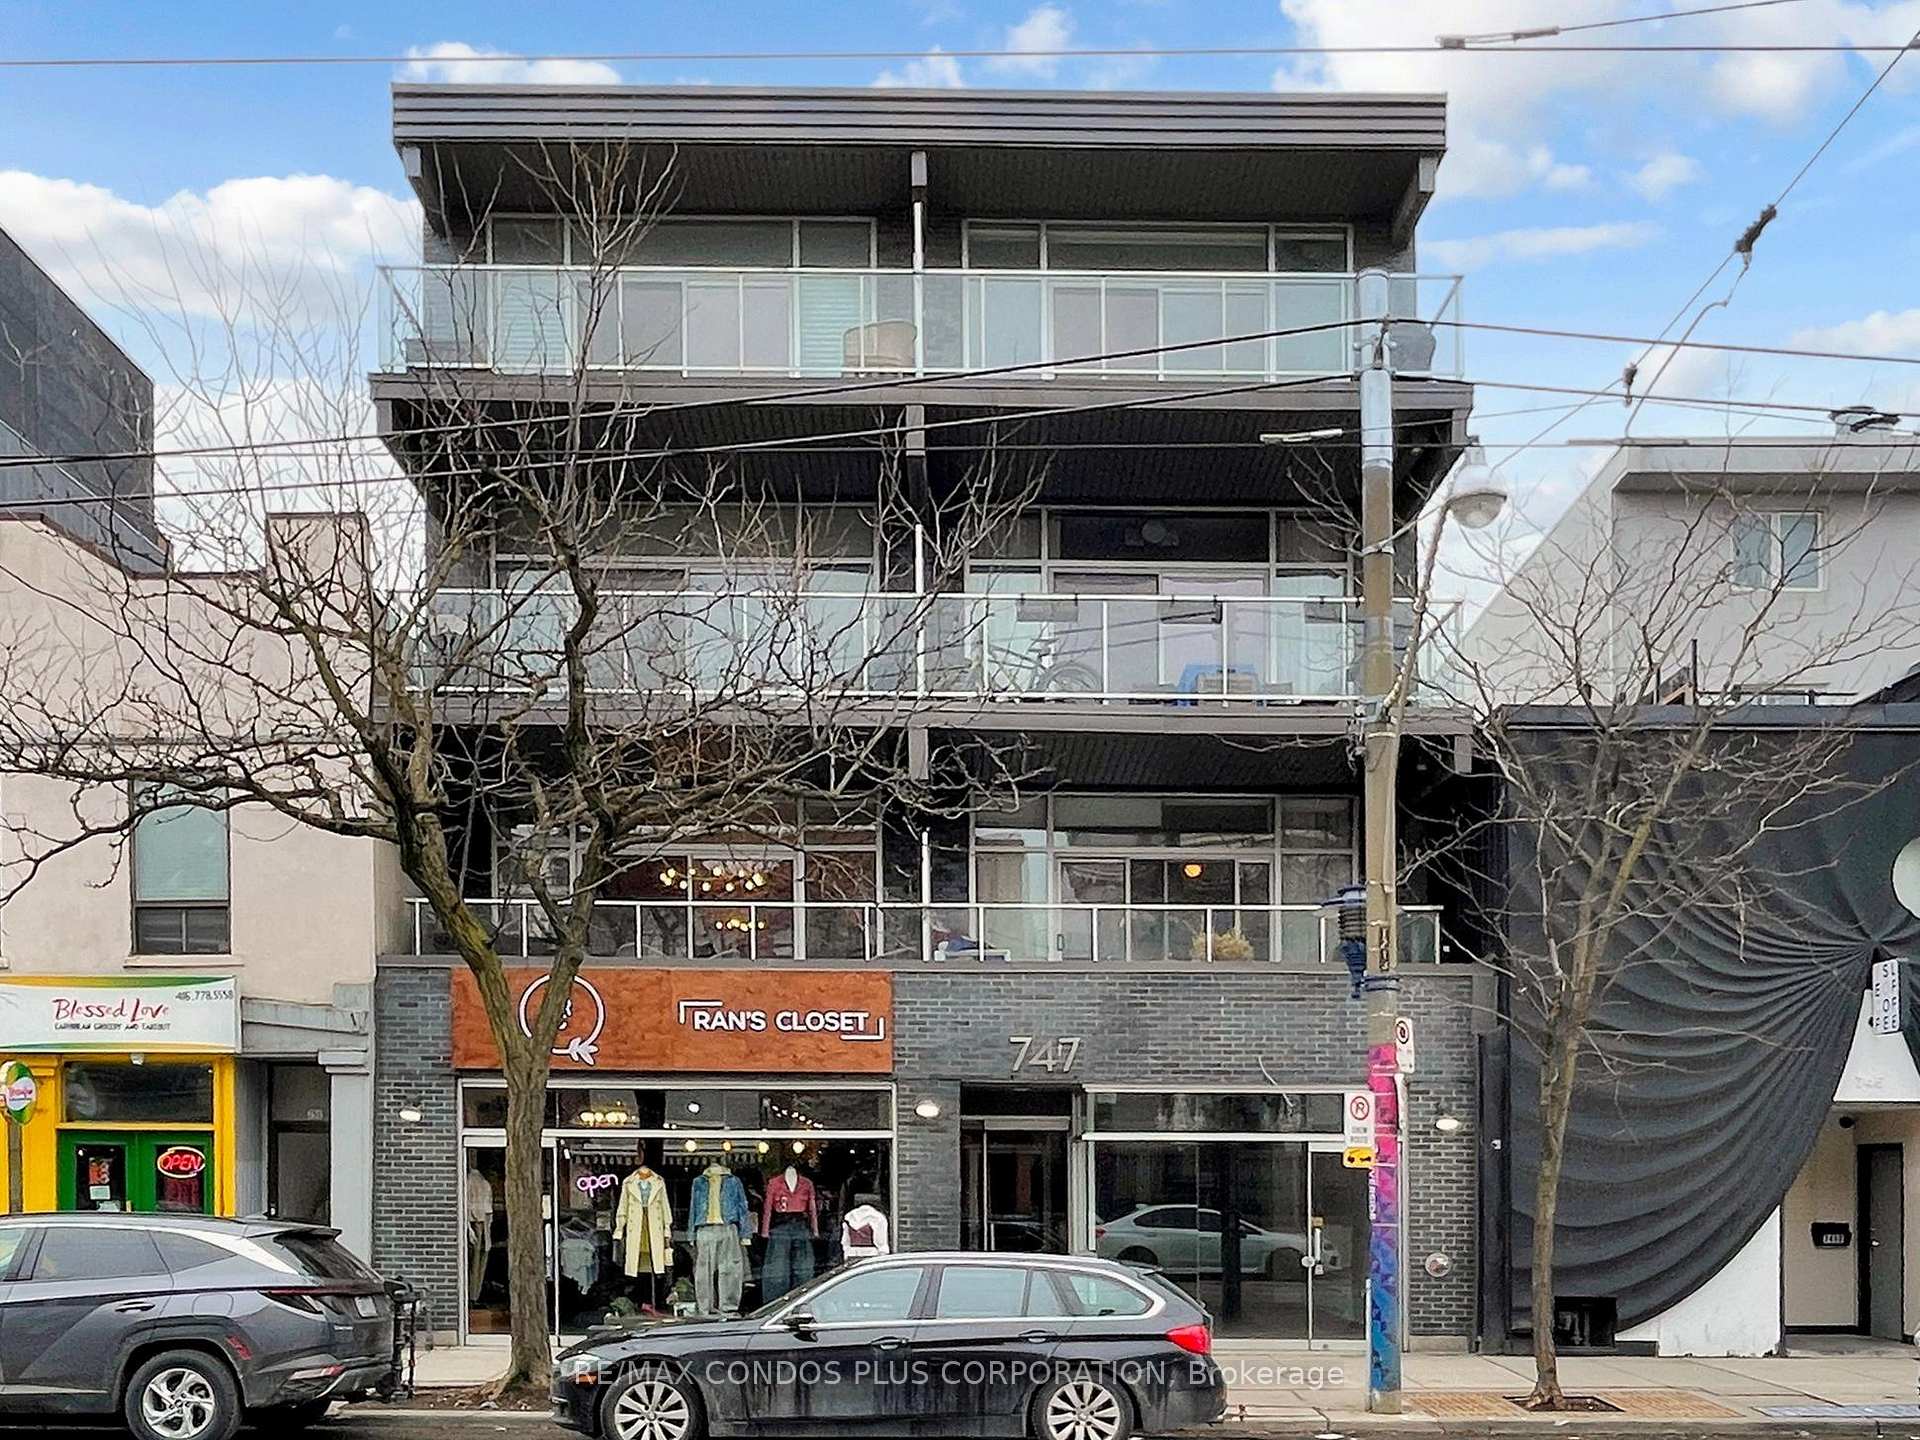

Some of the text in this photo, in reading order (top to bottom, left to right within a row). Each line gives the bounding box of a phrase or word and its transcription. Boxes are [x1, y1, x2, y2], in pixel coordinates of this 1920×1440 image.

[52, 998, 169, 1022] Blessed Love
[693, 1011, 869, 1031] RAN'S CLOSET
[1009, 1036, 1081, 1072] 747
[160, 1154, 201, 1172] OPEN
[576, 1174, 619, 1198] open
